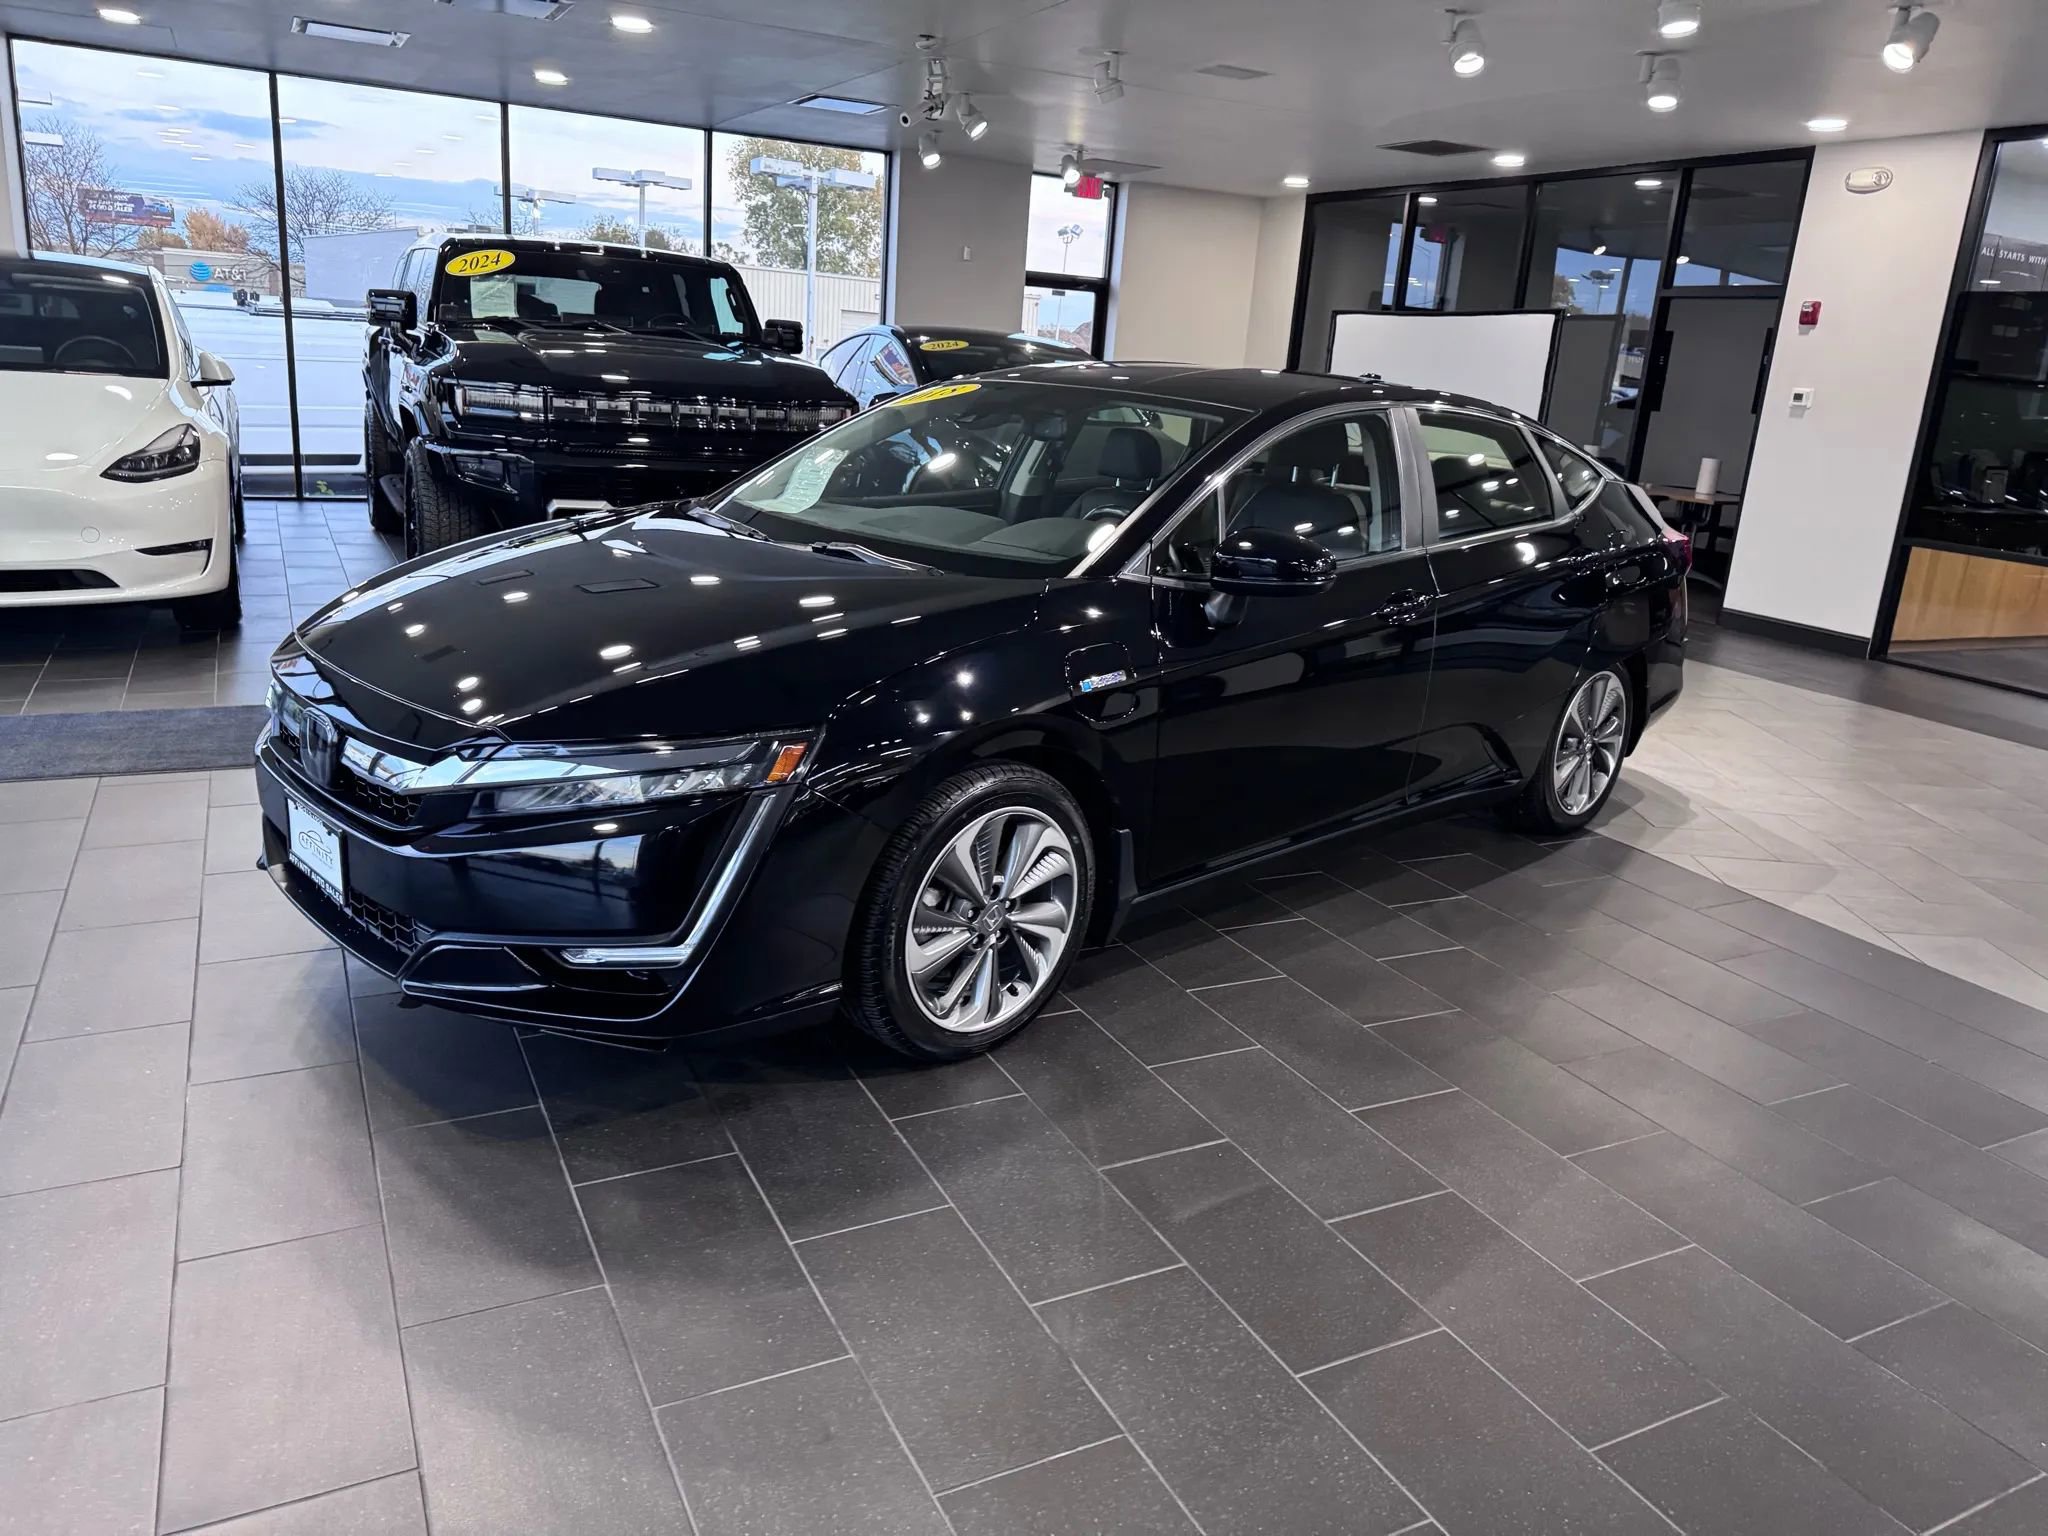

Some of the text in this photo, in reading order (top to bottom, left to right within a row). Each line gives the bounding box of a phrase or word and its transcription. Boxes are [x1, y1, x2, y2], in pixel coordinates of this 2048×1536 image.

[458, 252, 502, 273] 2024
[1981, 246, 2047, 265] ALL STARTS WITH
[214, 267, 247, 280] AT&T
[930, 341, 960, 350] 2024
[301, 834, 333, 865] AFFINITY
[289, 853, 311, 877] AFFINITY
[311, 872, 326, 889] AUTO
[325, 882, 343, 904] SALES
